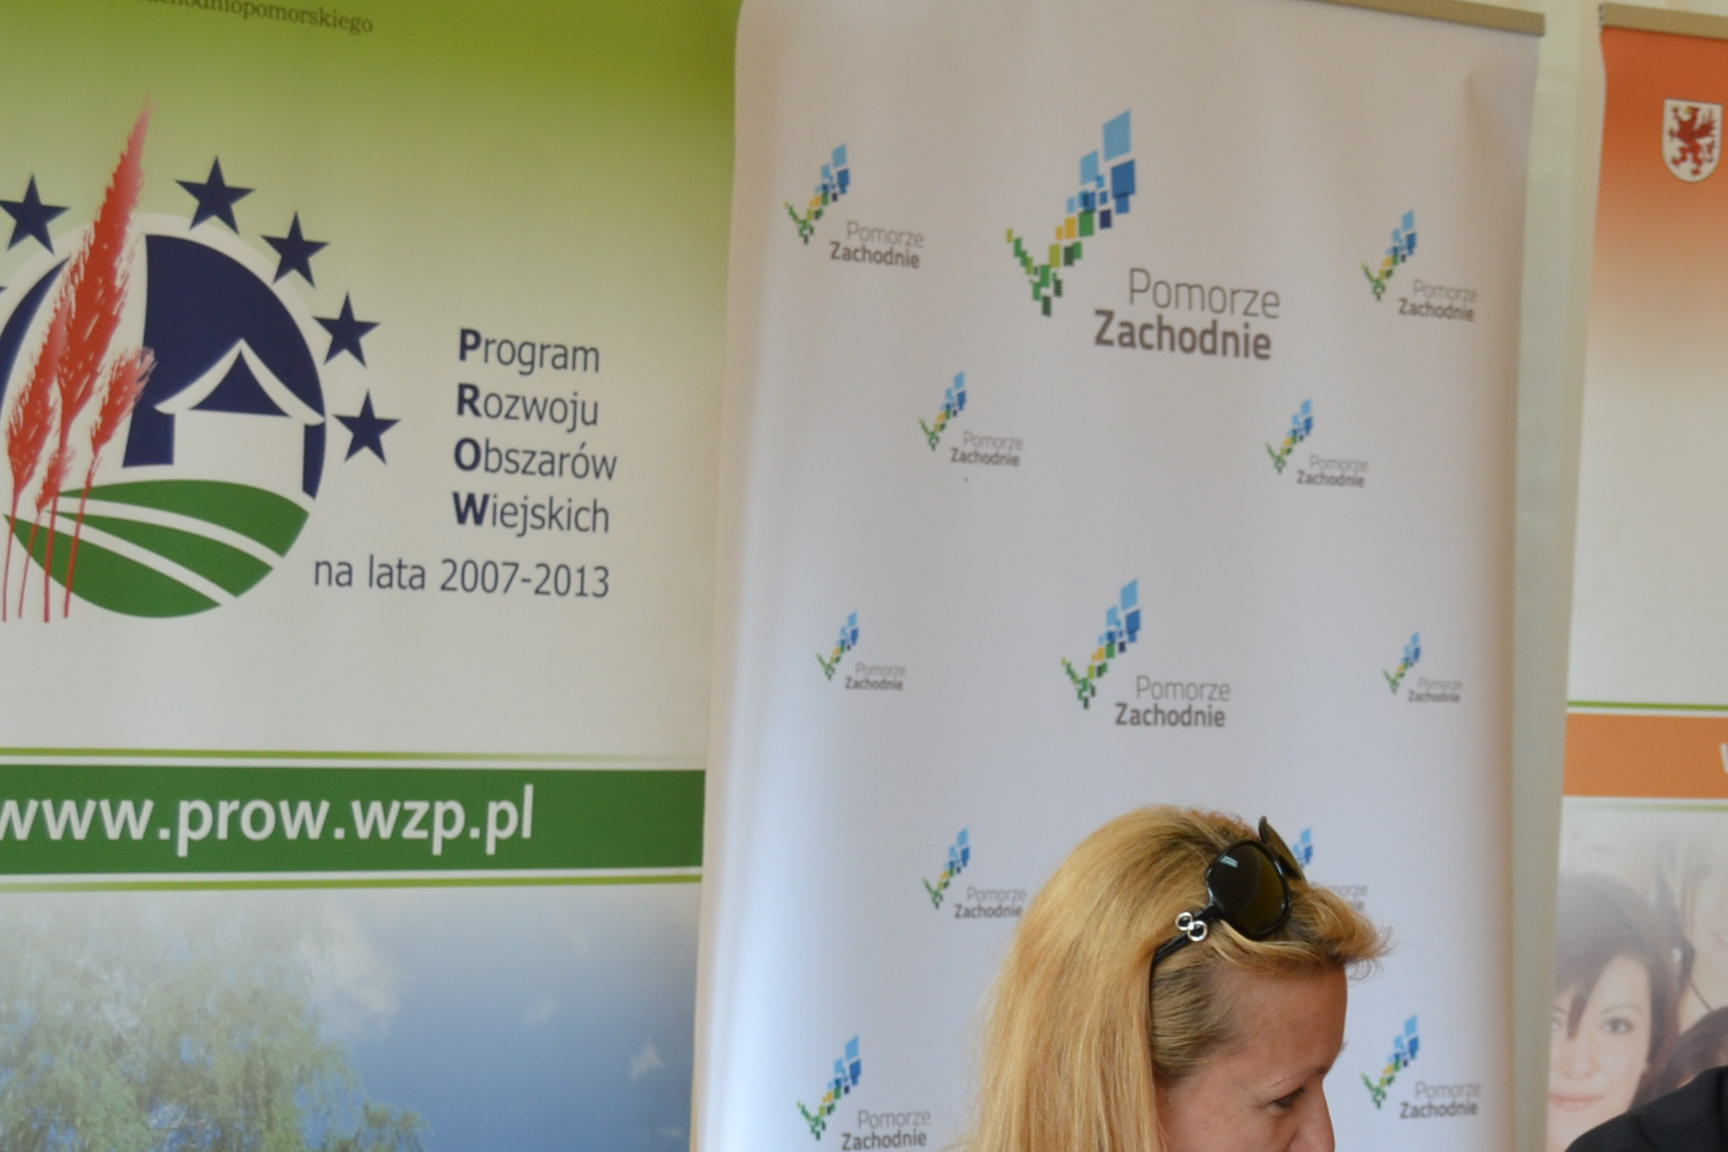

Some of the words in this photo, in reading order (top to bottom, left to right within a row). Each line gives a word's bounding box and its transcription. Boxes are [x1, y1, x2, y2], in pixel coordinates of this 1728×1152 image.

[847, 220, 925, 249] Pomorze
[830, 240, 920, 269] Zachodnie
[1129, 267, 1281, 319] Pomorze
[1413, 278, 1478, 304] Pomorze
[1399, 297, 1474, 322] Zachodnie
[1094, 308, 1272, 360] Zachodnie
[458, 327, 600, 376] Program
[455, 382, 600, 434] Rozwoju
[963, 430, 1024, 451] Pomorze
[454, 437, 618, 481] Obszarów
[951, 446, 1021, 468] Zachodnie
[1310, 453, 1368, 475] Pomorze
[1296, 470, 1365, 489] Zachodnie
[451, 490, 609, 537] Wiejskich
[314, 560, 354, 587] na
[367, 555, 427, 590] lata
[440, 558, 610, 599] 2007-2013
[845, 676, 903, 692] Zachodnie
[1136, 674, 1231, 702] Pomorze
[1115, 701, 1226, 728] Zachodnie
[0, 783, 534, 858] www.prow.wzp.pl
[967, 885, 1027, 902] Pomorze
[954, 903, 1024, 919] Zachodnie
[1416, 1081, 1481, 1099] Pomorze
[858, 1110, 931, 1129] Pomorze
[1400, 1101, 1477, 1119] Zachodnie
[841, 1128, 927, 1152] Zachodnie
